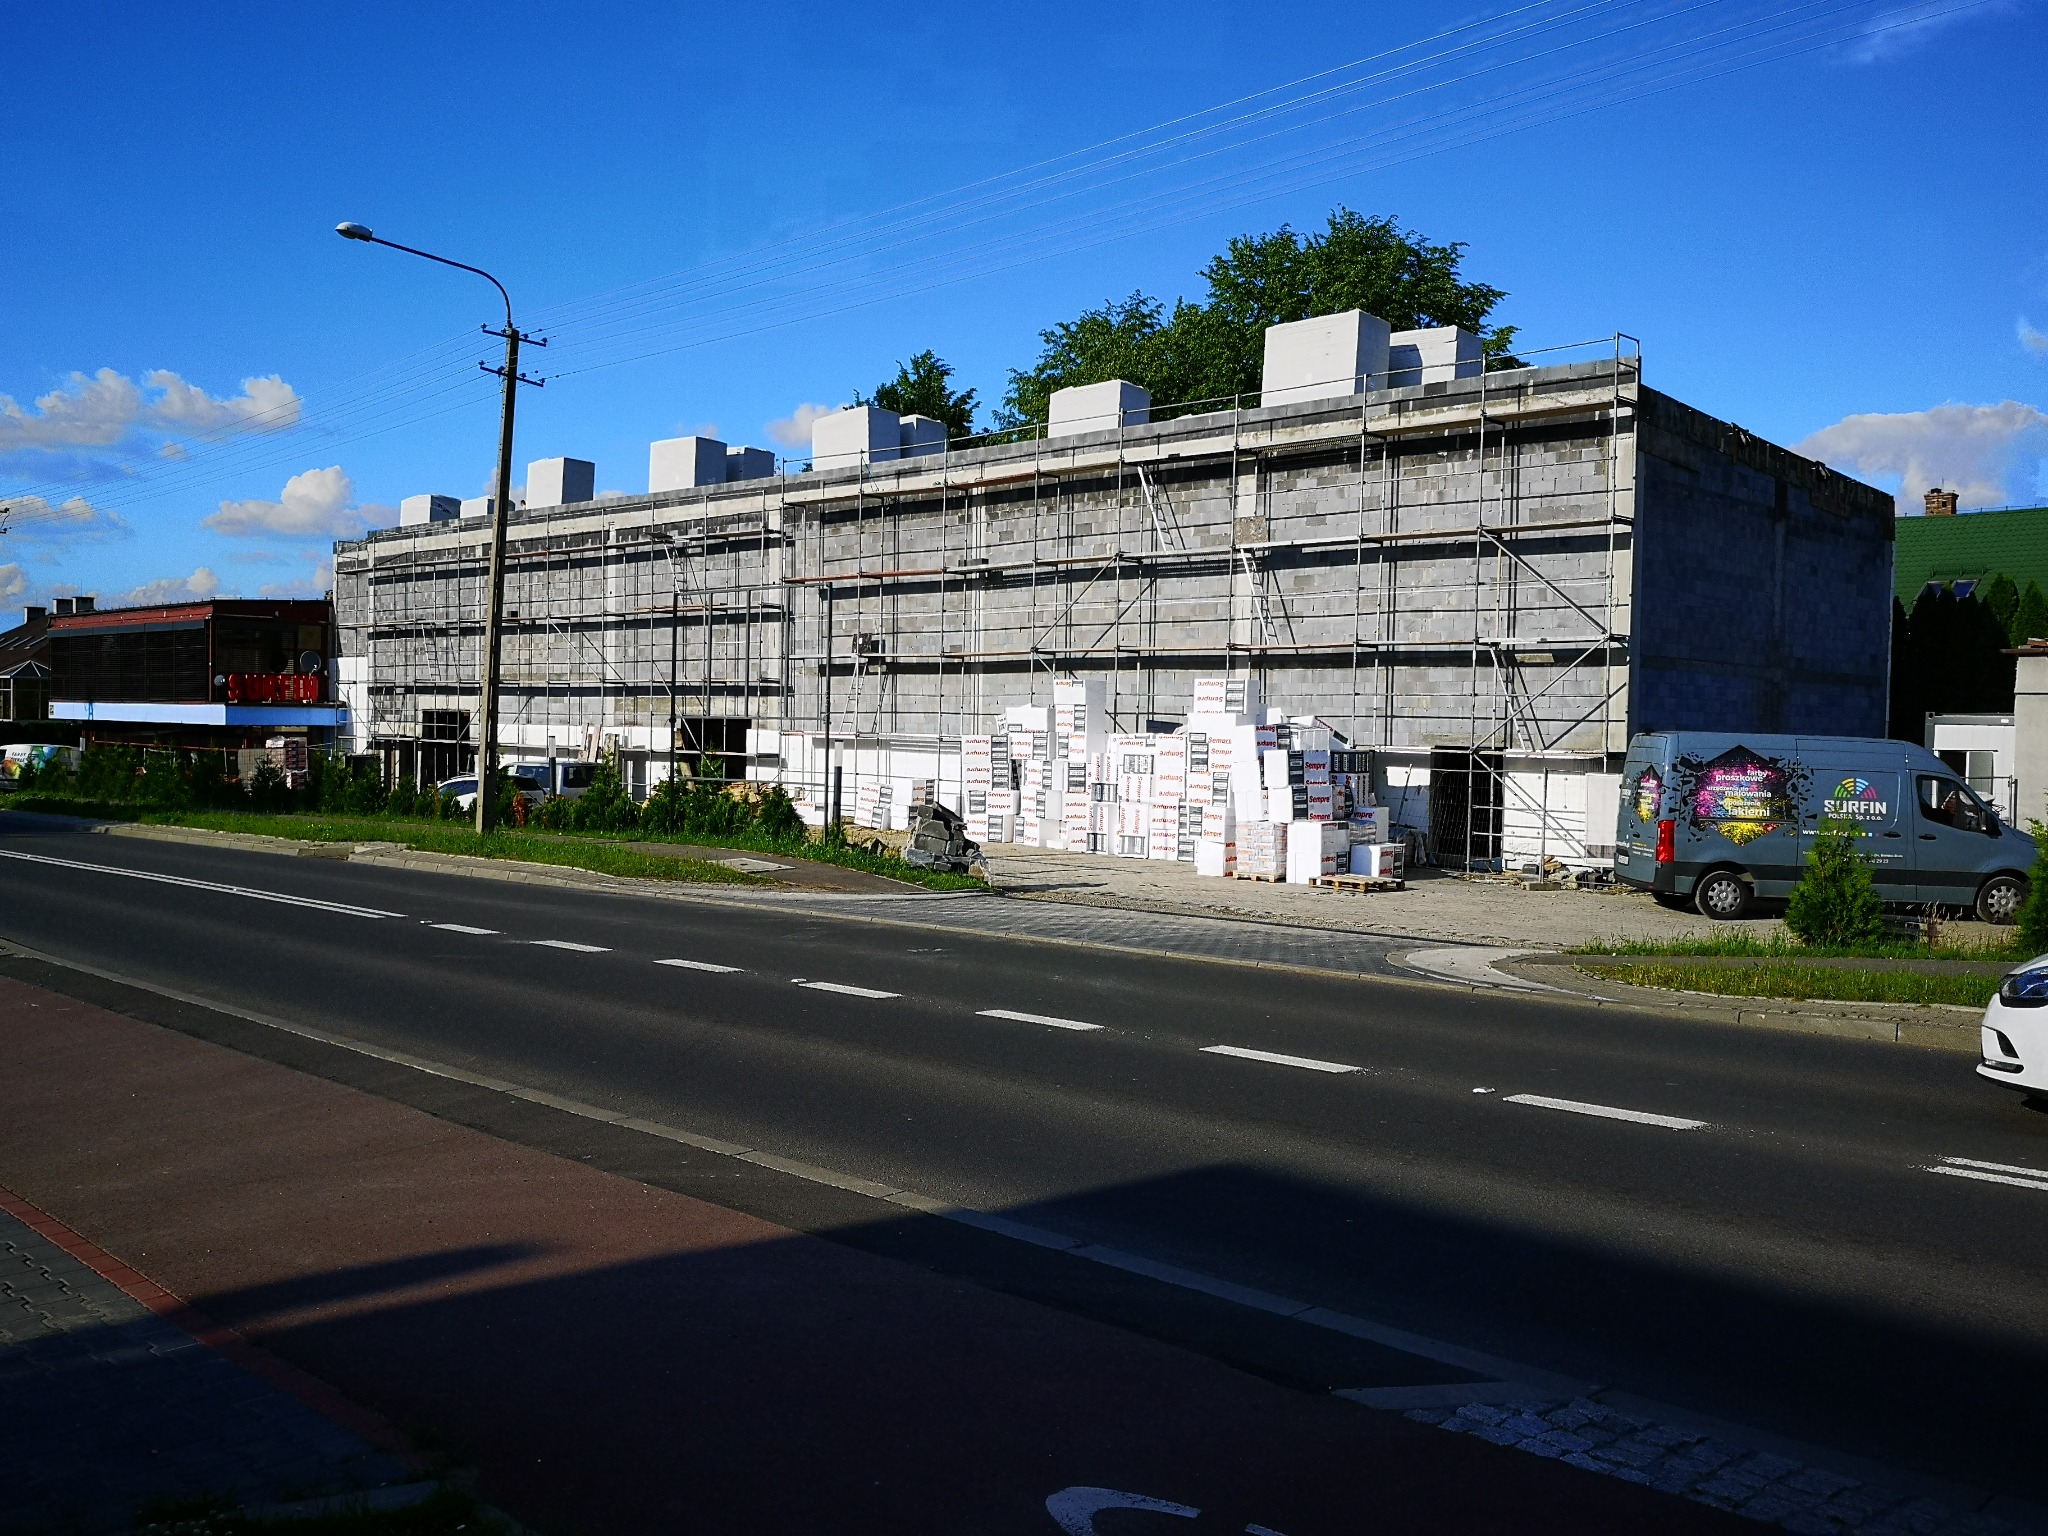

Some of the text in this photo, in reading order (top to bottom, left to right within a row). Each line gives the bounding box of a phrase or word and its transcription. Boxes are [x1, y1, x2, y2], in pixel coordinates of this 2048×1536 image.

[228, 673, 318, 701] SURFIN
[1160, 750, 1184, 758] Sempre
[1305, 762, 1327, 770] Sempre
[1716, 774, 1764, 782] proszkowe
[1747, 770, 1768, 778] farby
[1159, 775, 1184, 783] Sempre
[1725, 790, 1772, 798] malowania
[1309, 795, 1331, 803] Sempre
[1824, 800, 1887, 814] SURFIN
[1204, 812, 1222, 820] Sempre
[1729, 807, 1770, 817] lakierni
[1204, 829, 1222, 837] Sempre
